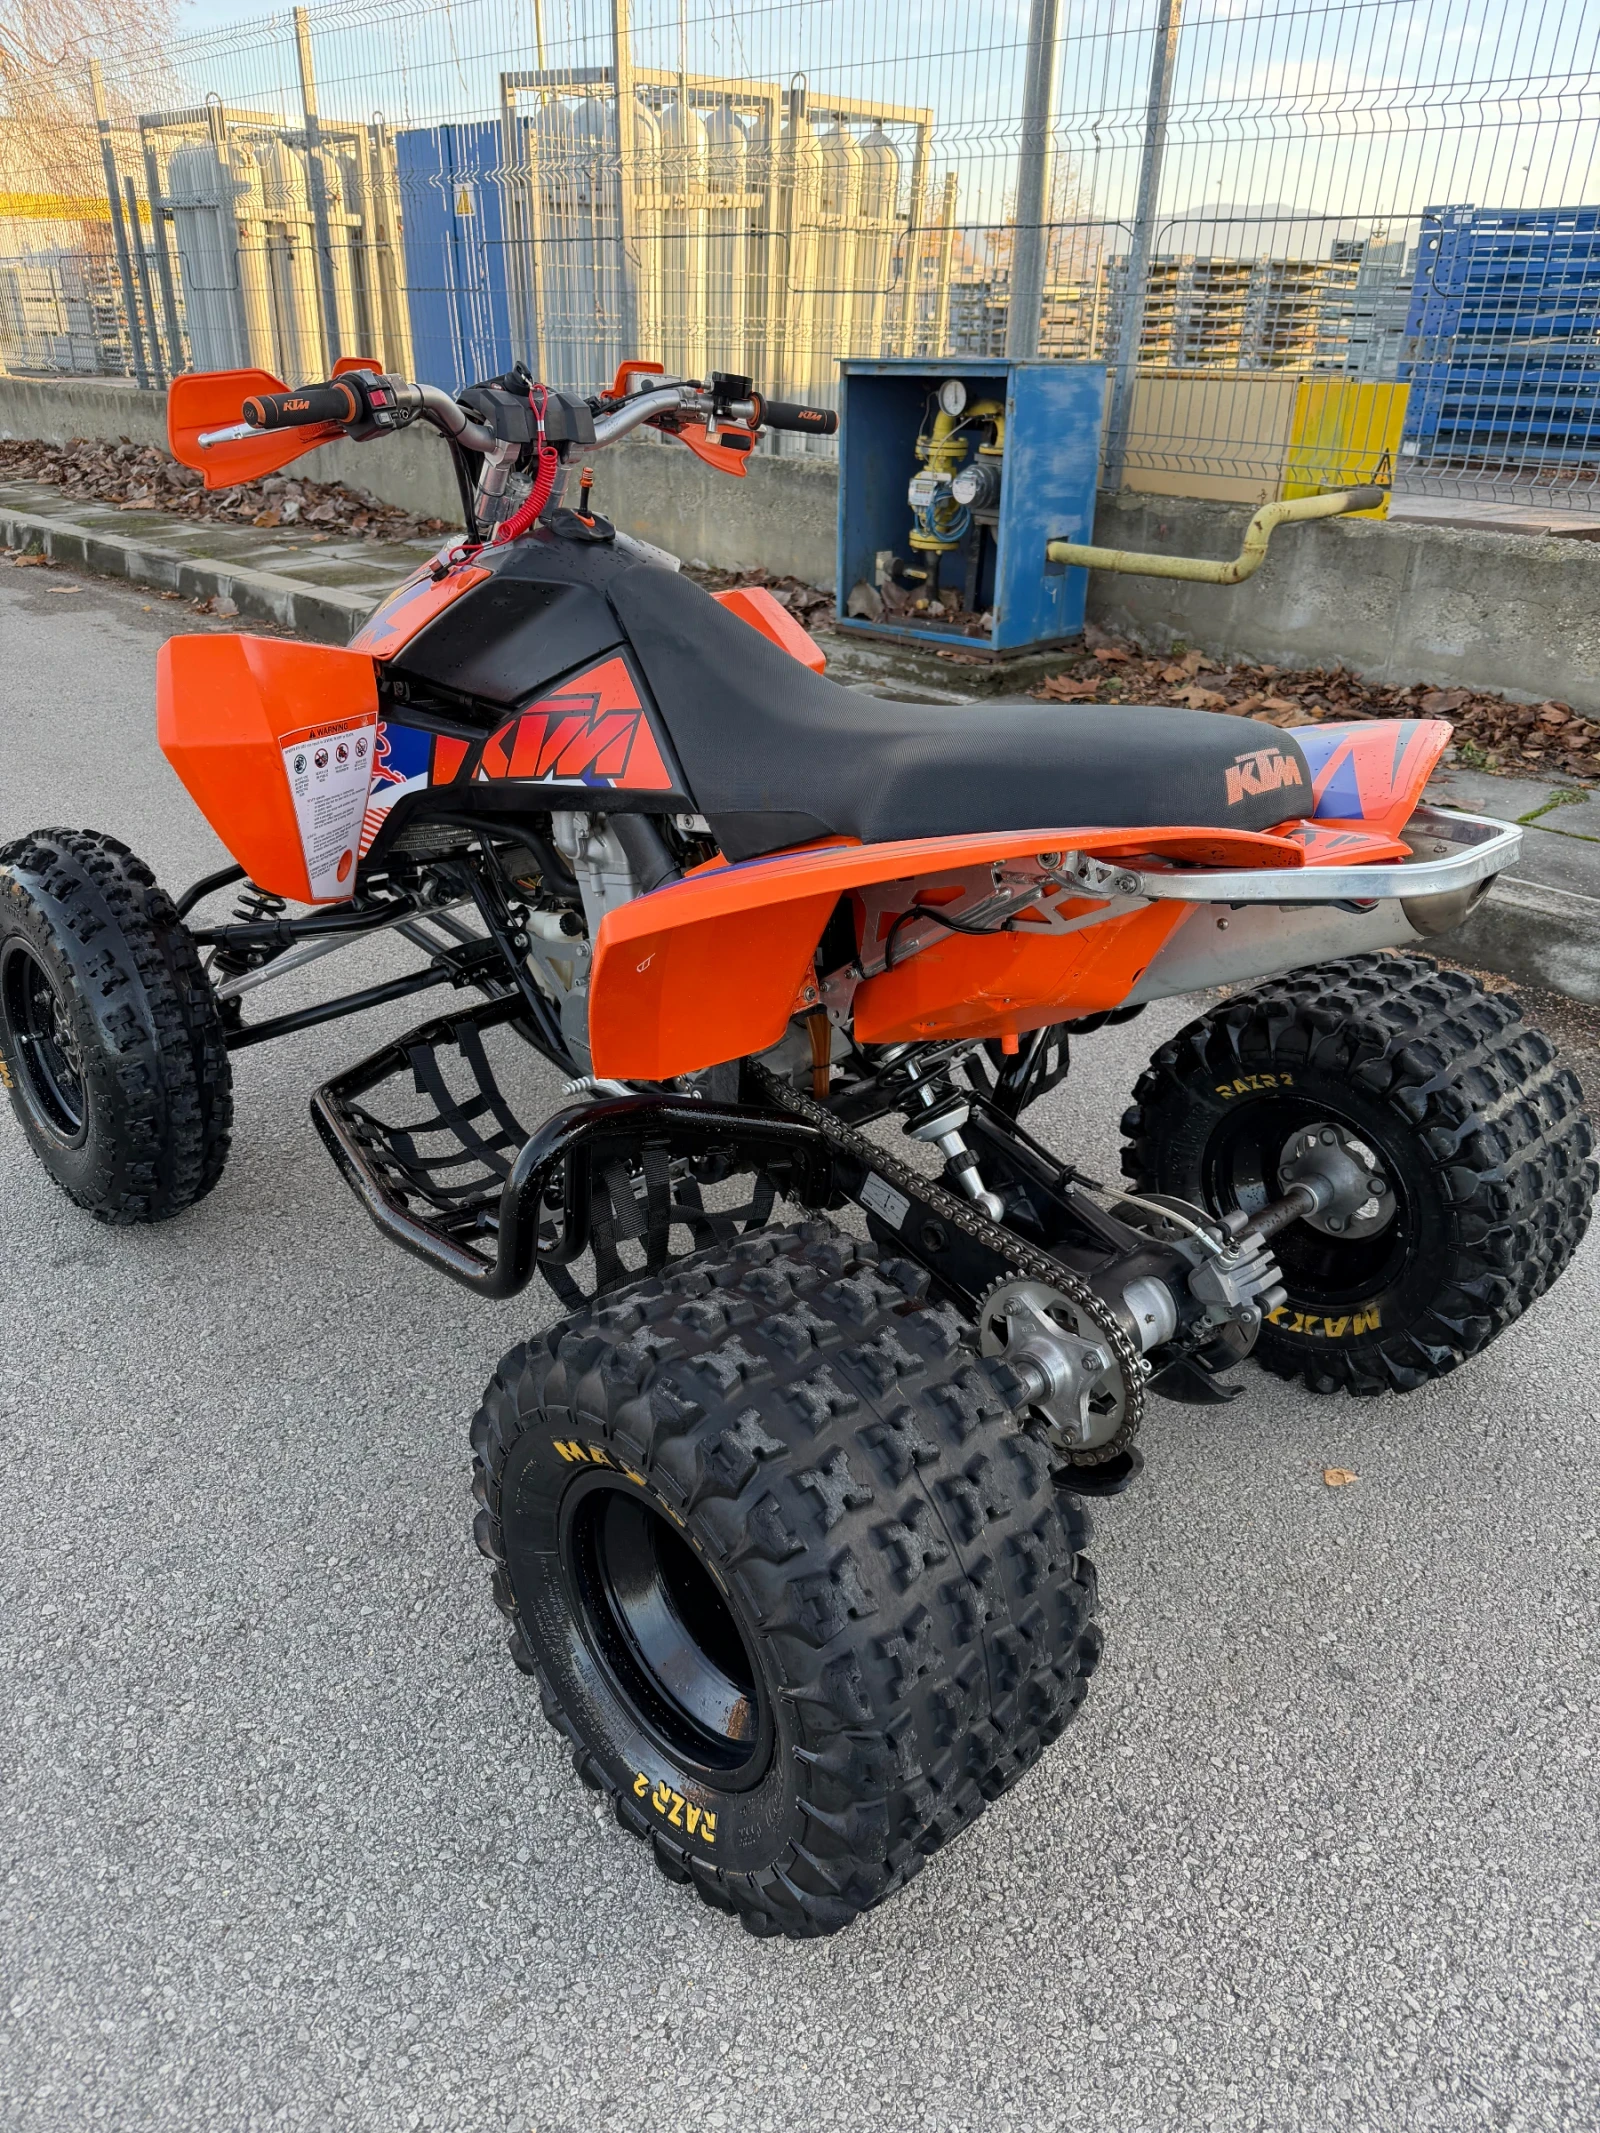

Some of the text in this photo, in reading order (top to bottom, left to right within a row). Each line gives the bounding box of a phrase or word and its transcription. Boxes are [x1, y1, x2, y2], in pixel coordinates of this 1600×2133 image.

[283, 398, 310, 412] KTM
[798, 409, 823, 422] KTM
[316, 722, 349, 737] WARNING
[480, 697, 640, 779] KTM
[1225, 747, 1303, 806] KTM
[1215, 1073, 1294, 1100] RAZR 2
[633, 1772, 649, 1798] 2
[652, 1780, 717, 1843] RAZR
